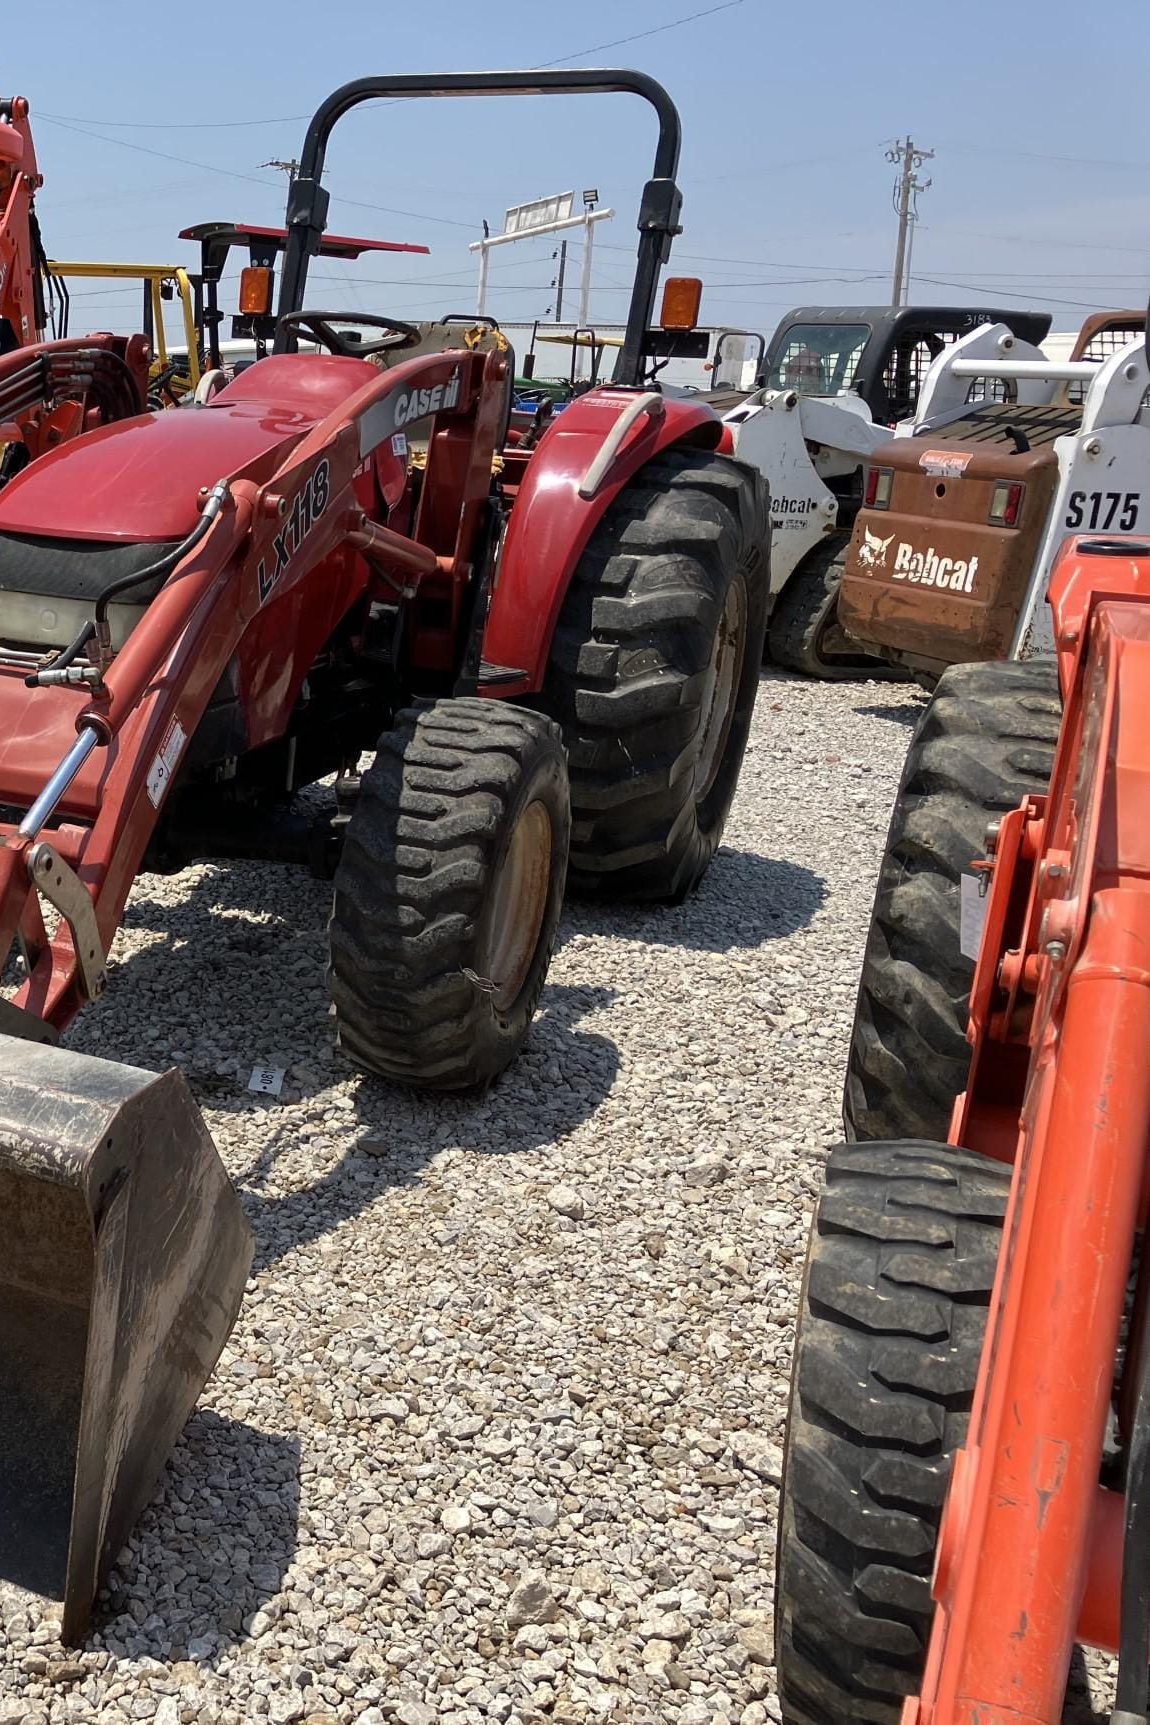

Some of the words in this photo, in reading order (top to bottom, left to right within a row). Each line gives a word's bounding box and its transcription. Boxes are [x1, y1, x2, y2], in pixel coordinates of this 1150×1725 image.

[394, 383, 445, 427] CASE
[257, 457, 330, 607] LX118
[1065, 490, 1141, 532] S175
[891, 542, 979, 594] Bobcat
